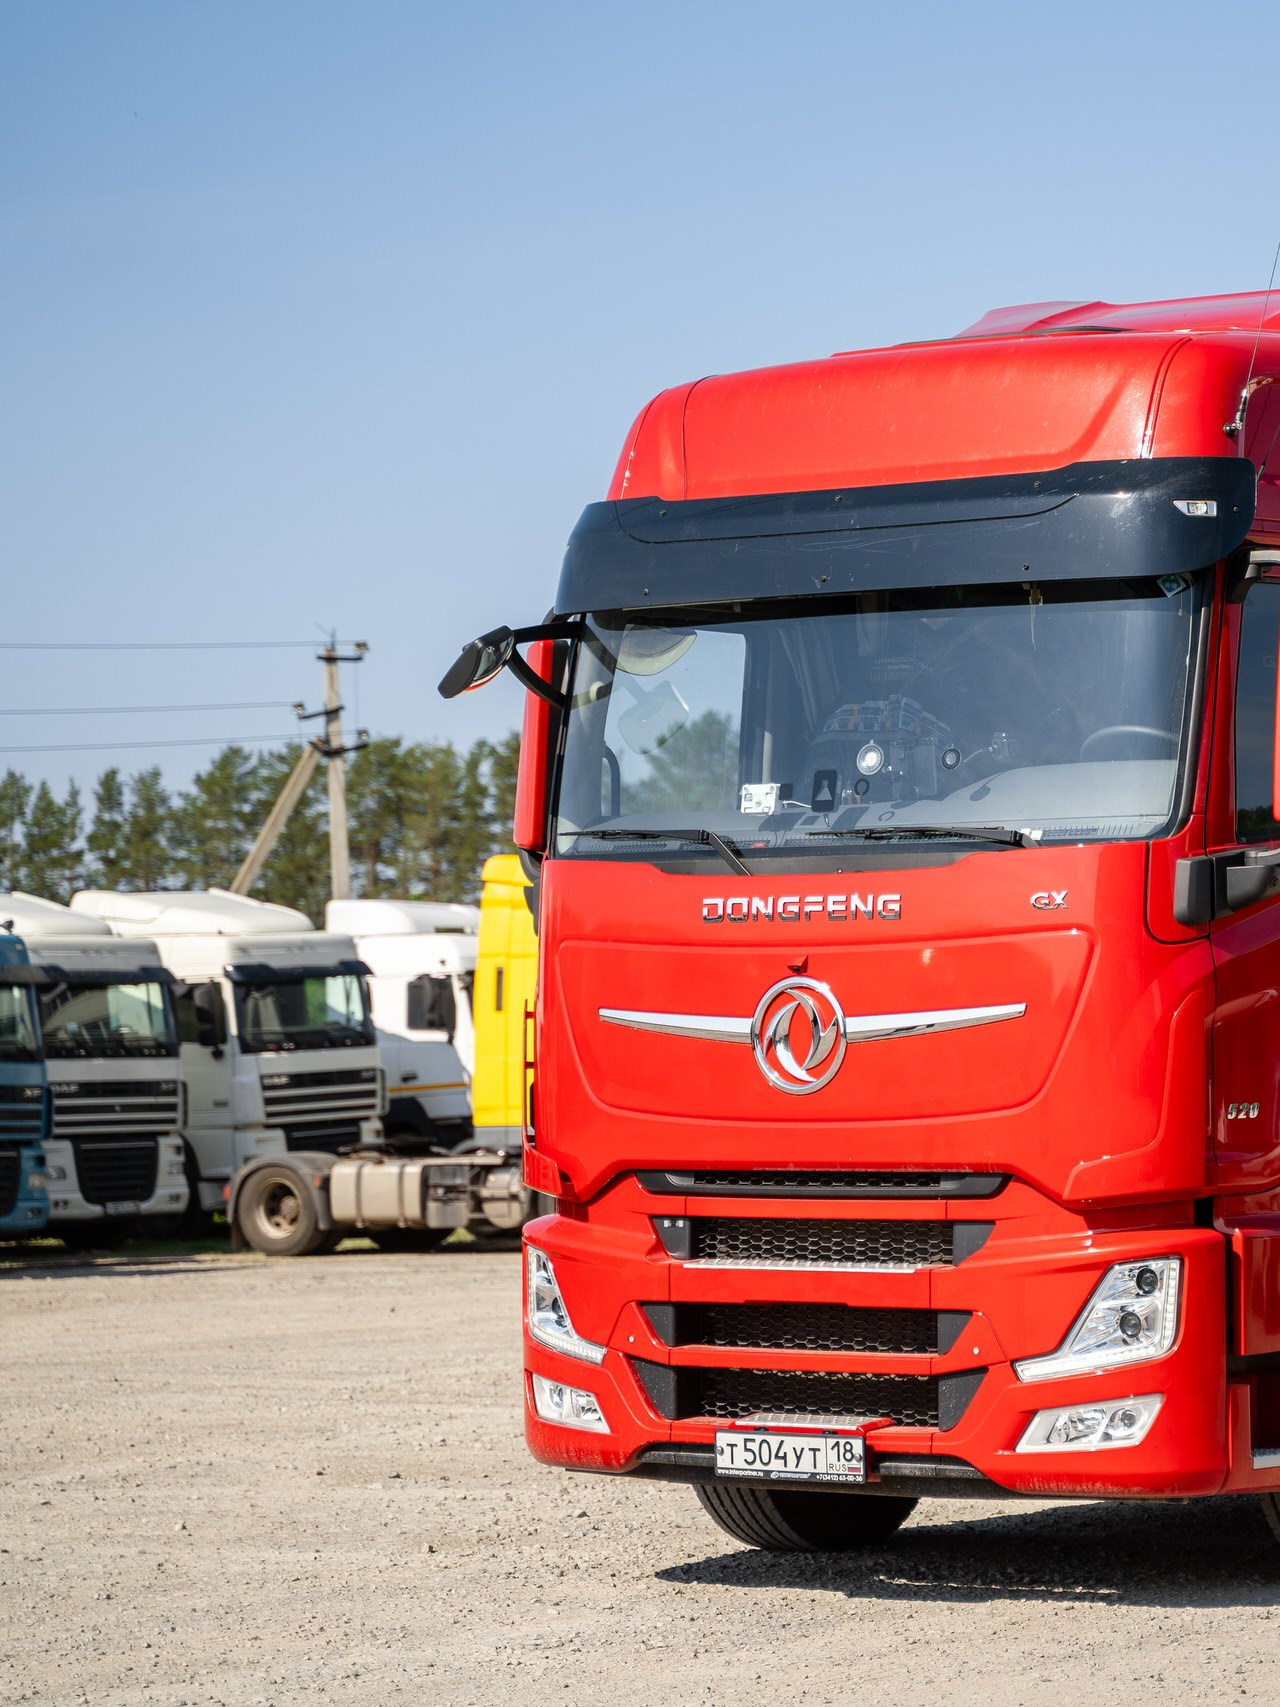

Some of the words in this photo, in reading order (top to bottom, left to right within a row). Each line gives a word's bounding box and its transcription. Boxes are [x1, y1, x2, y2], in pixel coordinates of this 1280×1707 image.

[702, 894, 901, 923] DONGFENG
[1029, 890, 1069, 910] GX
[1227, 1102, 1260, 1120] 520
[830, 1440, 854, 1463] 18
[828, 1463, 847, 1473] RUS
